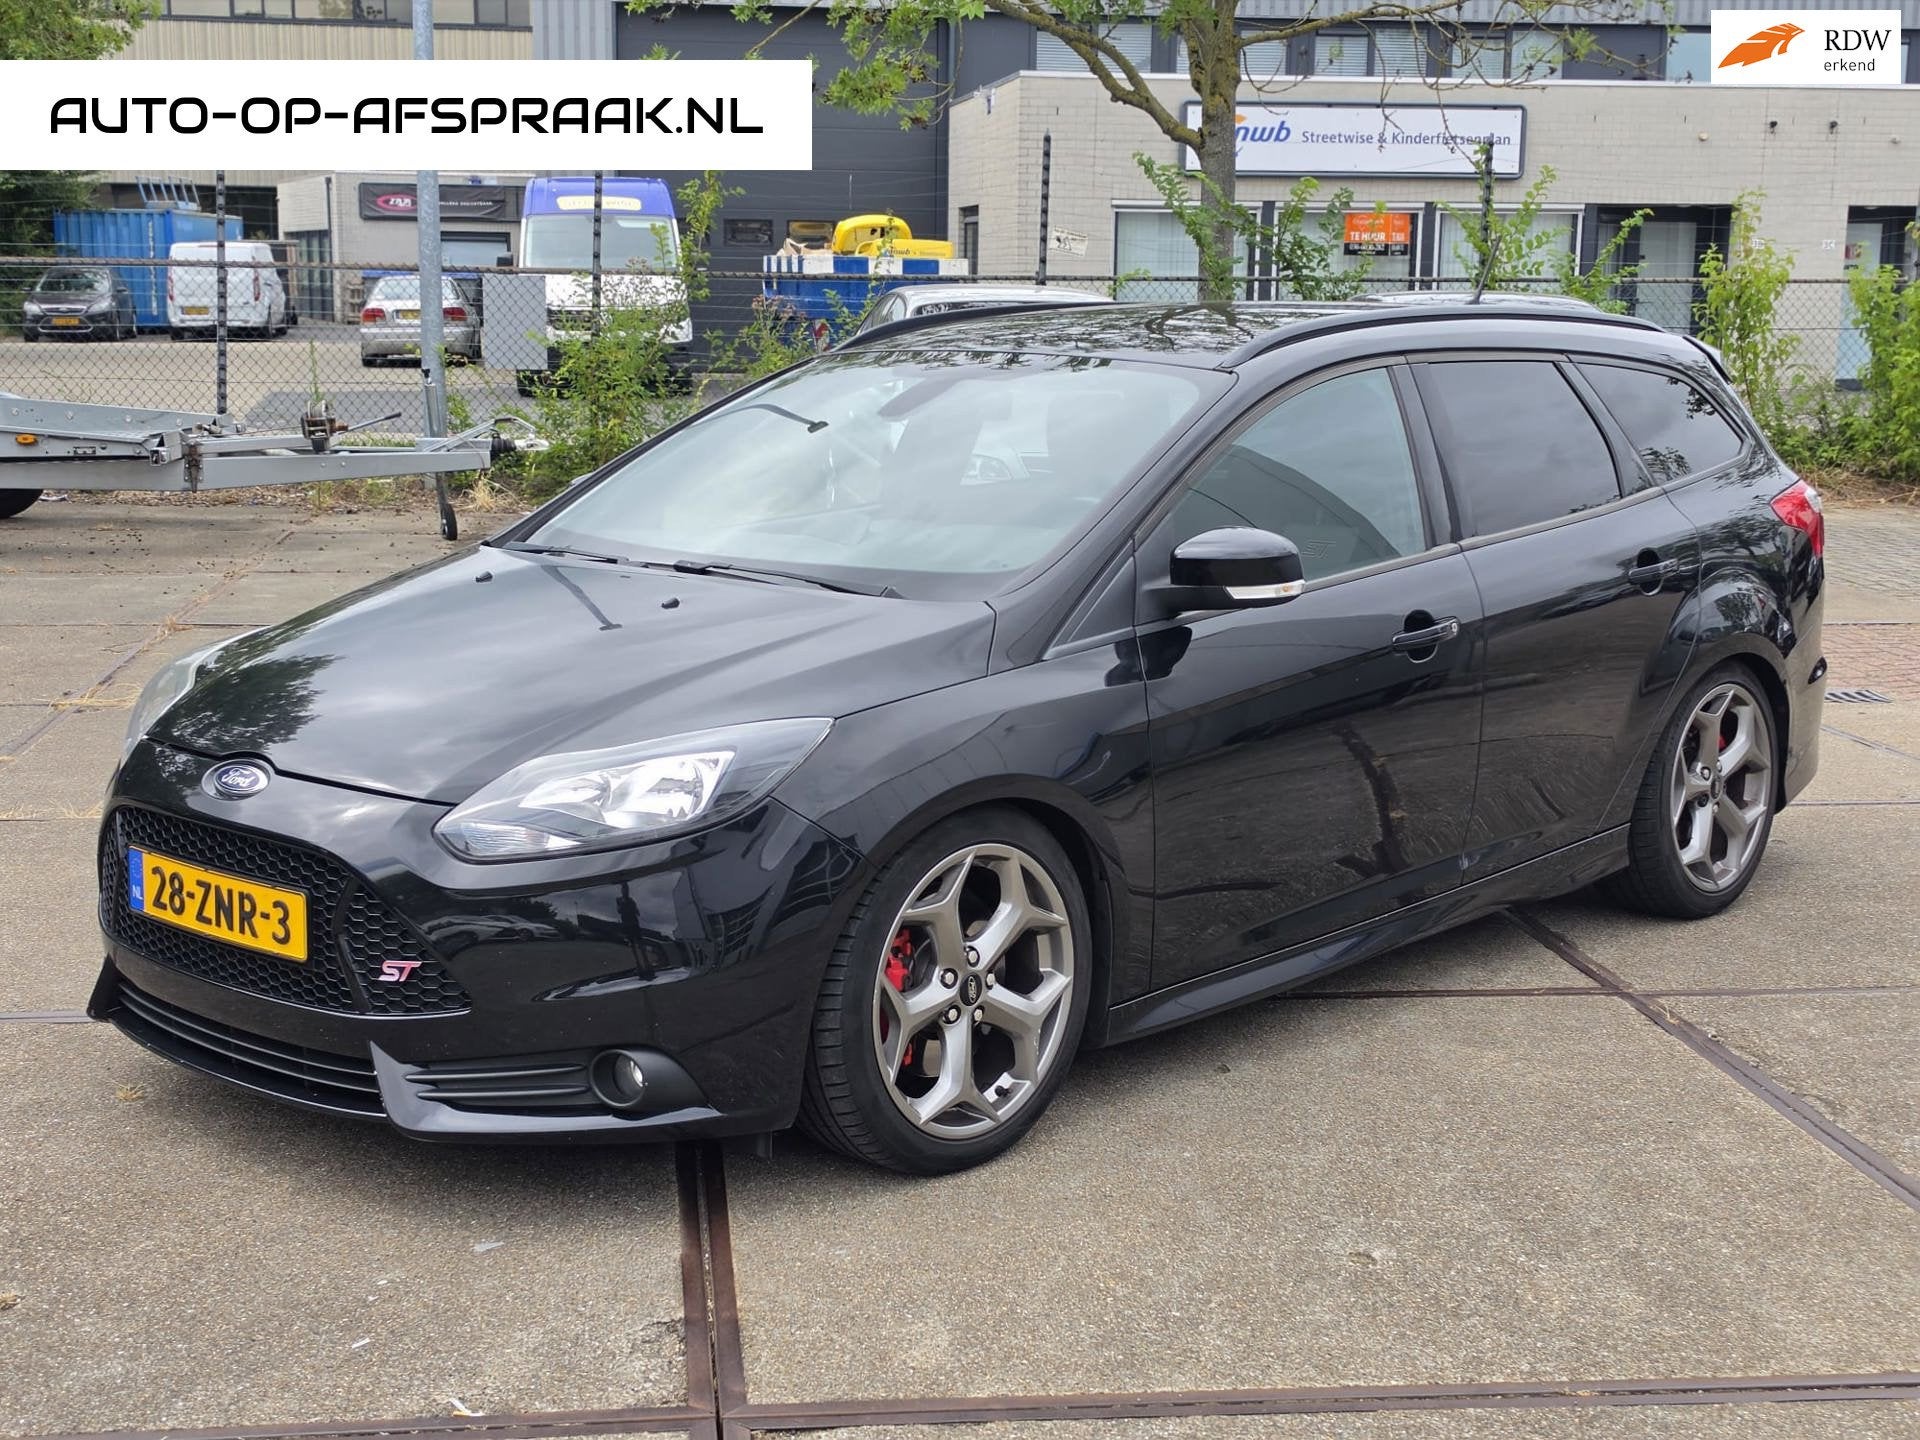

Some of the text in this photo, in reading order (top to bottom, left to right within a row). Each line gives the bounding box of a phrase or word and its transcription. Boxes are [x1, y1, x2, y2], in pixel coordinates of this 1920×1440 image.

[1235, 120, 1291, 142] nwb
[1301, 130, 1374, 144] Streetwise
[1377, 132, 1388, 144] &
[221, 766, 255, 787] Ford
[132, 884, 143, 900] NL
[151, 866, 292, 945] 28-ZNR-3
[378, 960, 422, 982] ST
